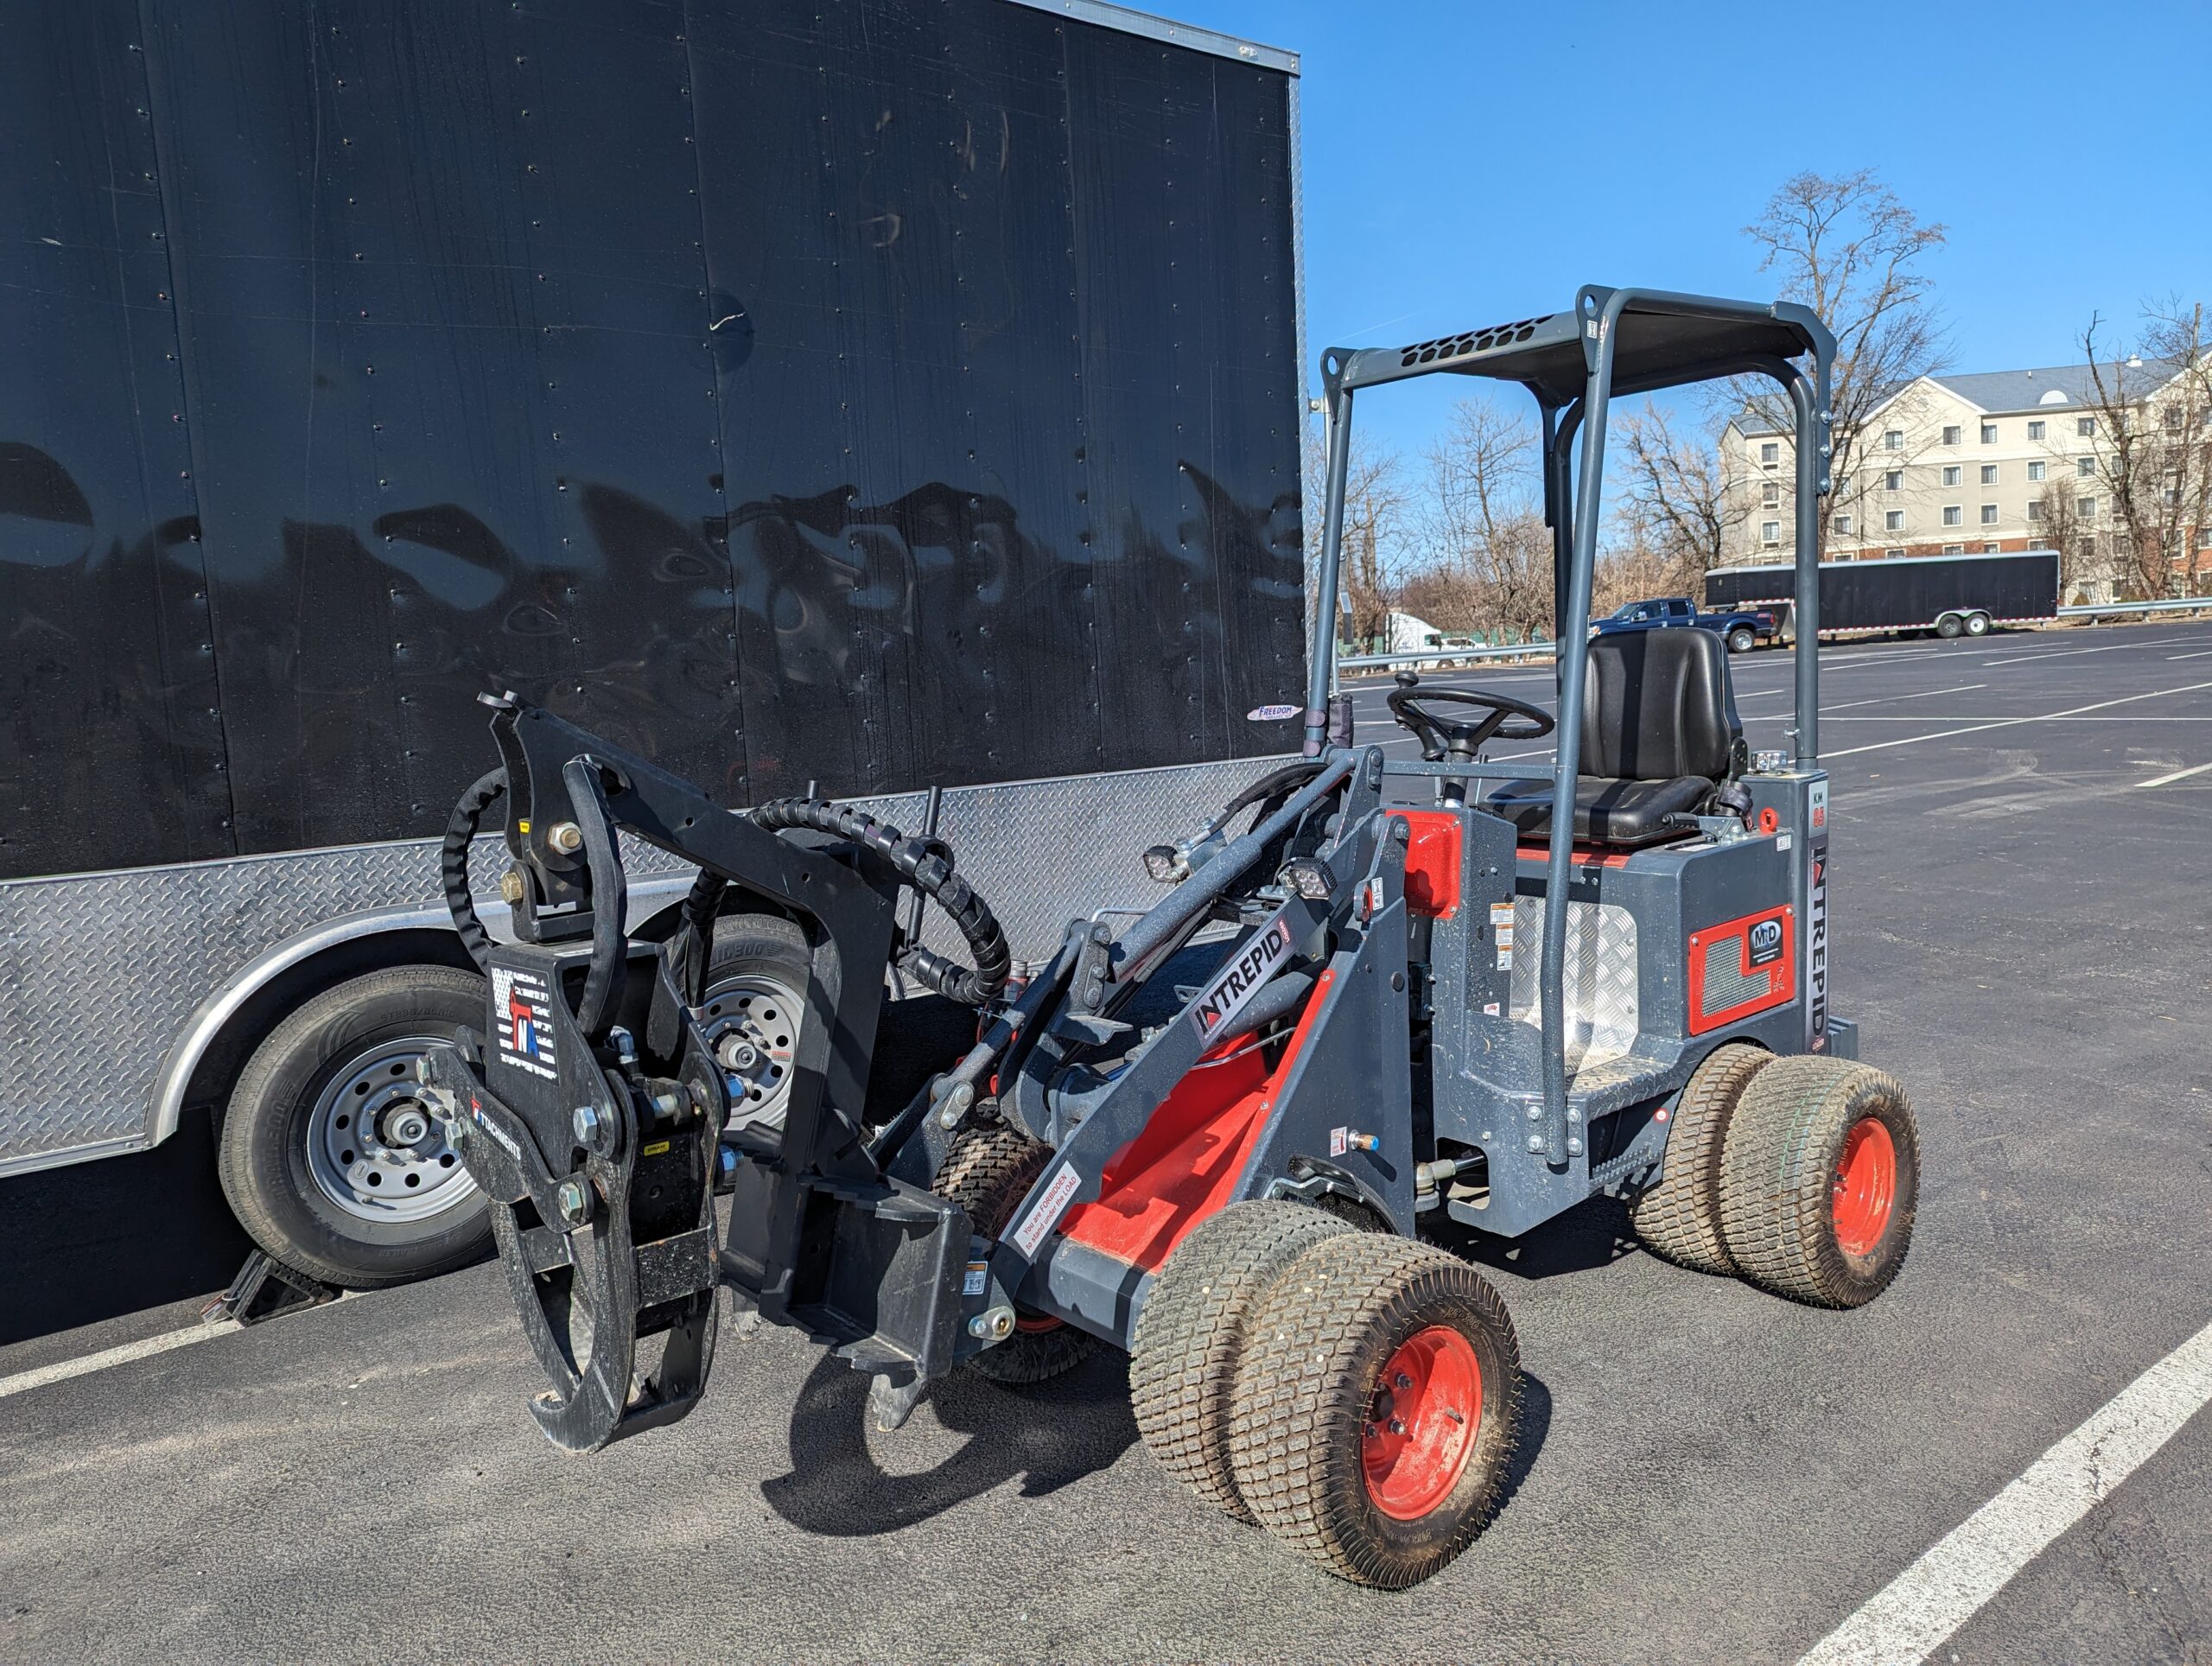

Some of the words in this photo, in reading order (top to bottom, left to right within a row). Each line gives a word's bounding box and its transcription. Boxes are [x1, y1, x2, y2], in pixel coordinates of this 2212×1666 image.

[1259, 707, 1293, 717] FREEDOM
[1813, 791, 1823, 804] KM
[1813, 846, 1827, 1037] INTREPID
[1194, 929, 1283, 1034] INTREPID
[1023, 1224, 1033, 1236] You
[1033, 1211, 1042, 1221] are
[1039, 1173, 1068, 1212] FORBIDDEN
[1026, 1242, 1033, 1250] to
[1031, 1223, 1045, 1243] stand
[1044, 1206, 1058, 1224] under
[1055, 1195, 1065, 1206] the
[1064, 1176, 1077, 1197] LOAD
